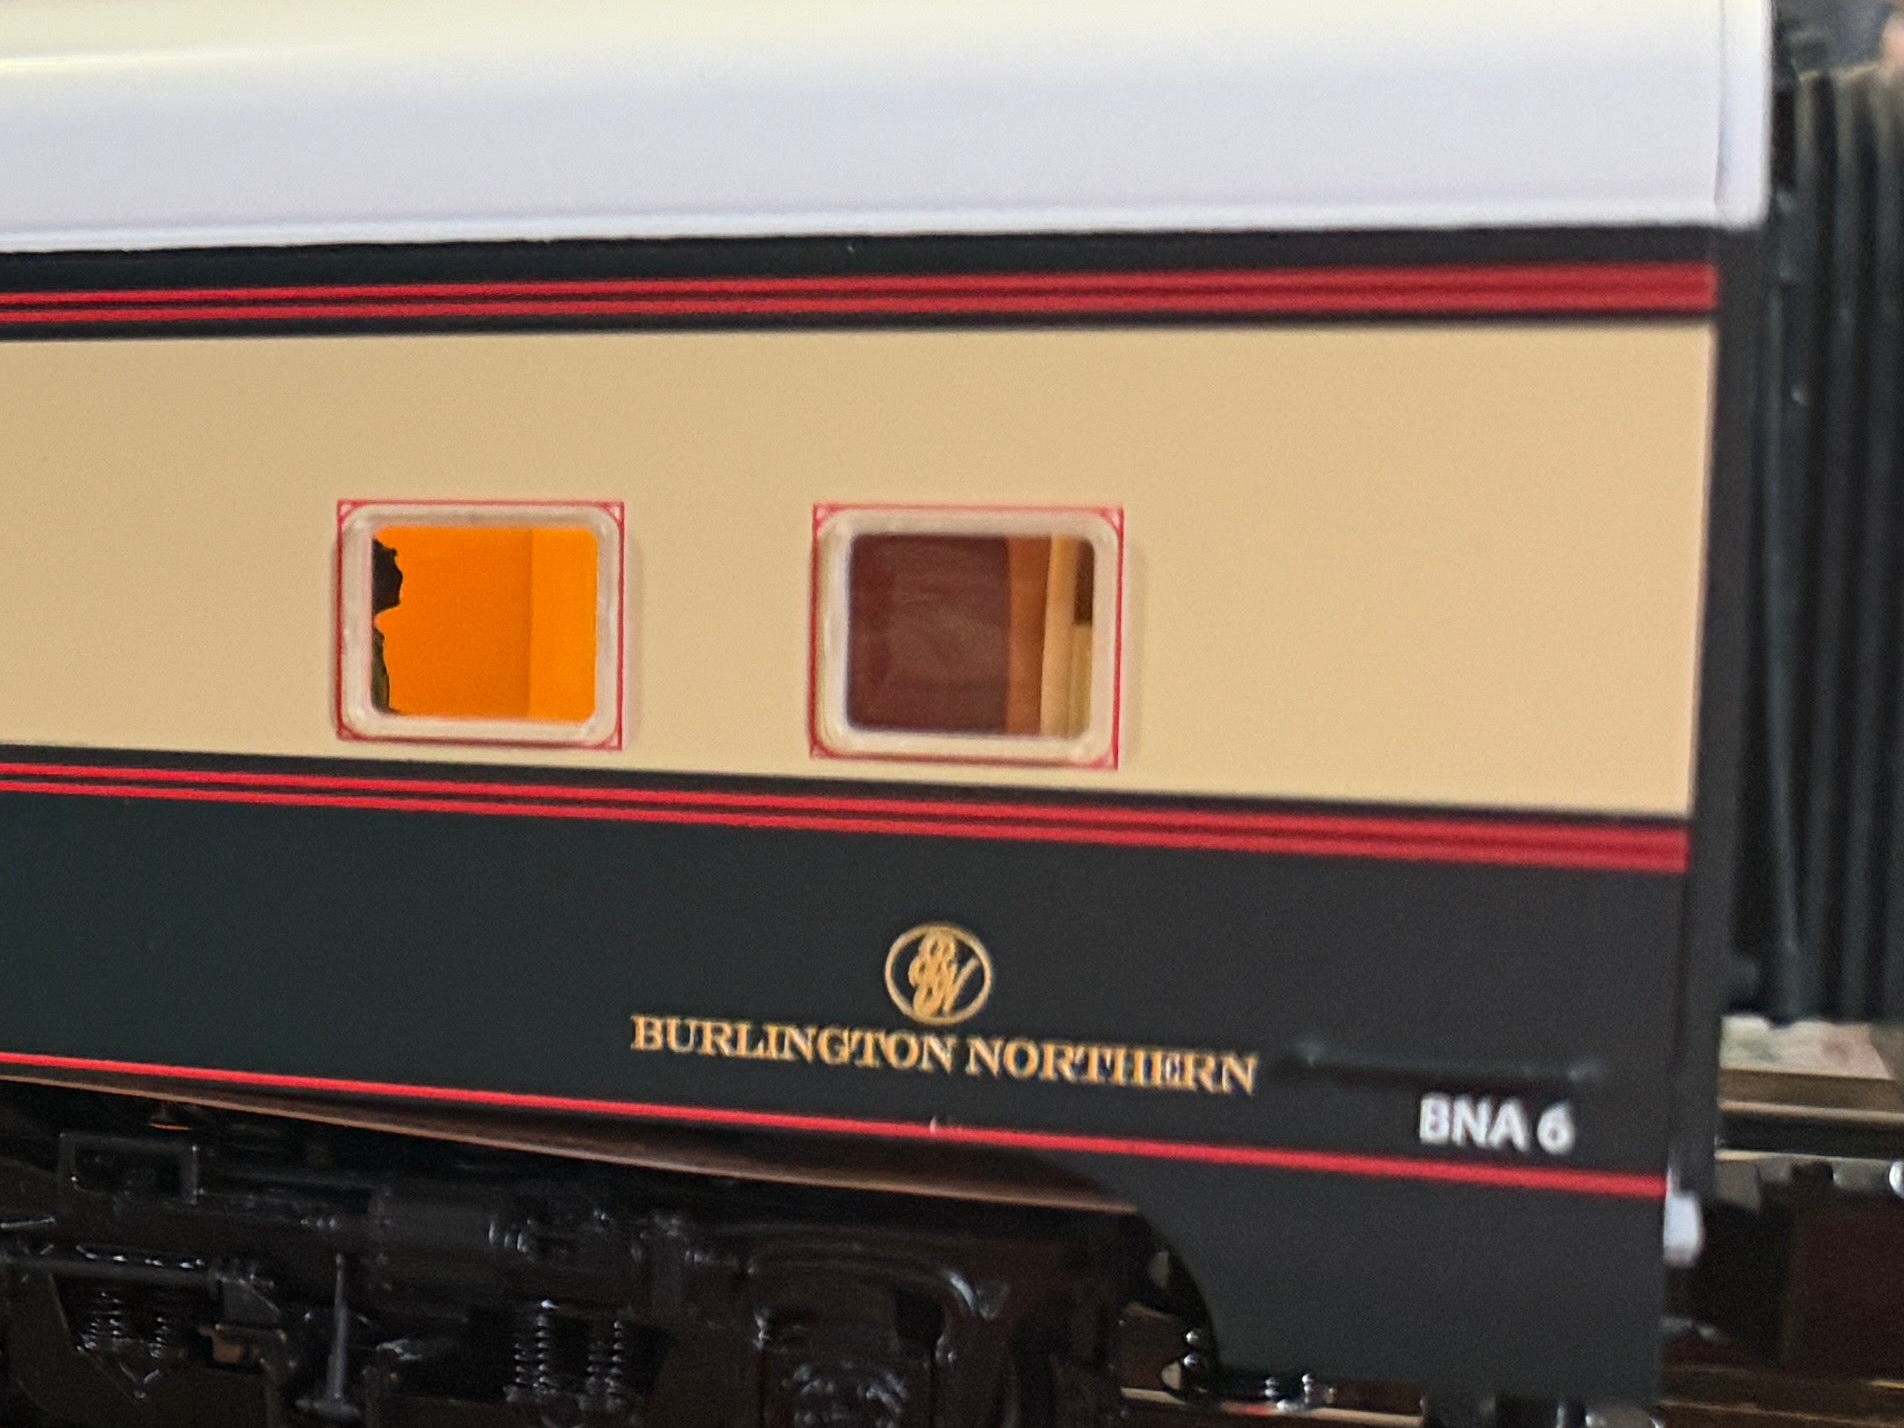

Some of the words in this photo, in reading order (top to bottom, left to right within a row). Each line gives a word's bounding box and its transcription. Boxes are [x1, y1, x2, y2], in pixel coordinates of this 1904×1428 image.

[630, 1014, 956, 1074] BURLINGTON
[965, 1036, 1258, 1096] NORTHERN
[1419, 1092, 1532, 1154] BNA
[1536, 1101, 1576, 1157] 6
